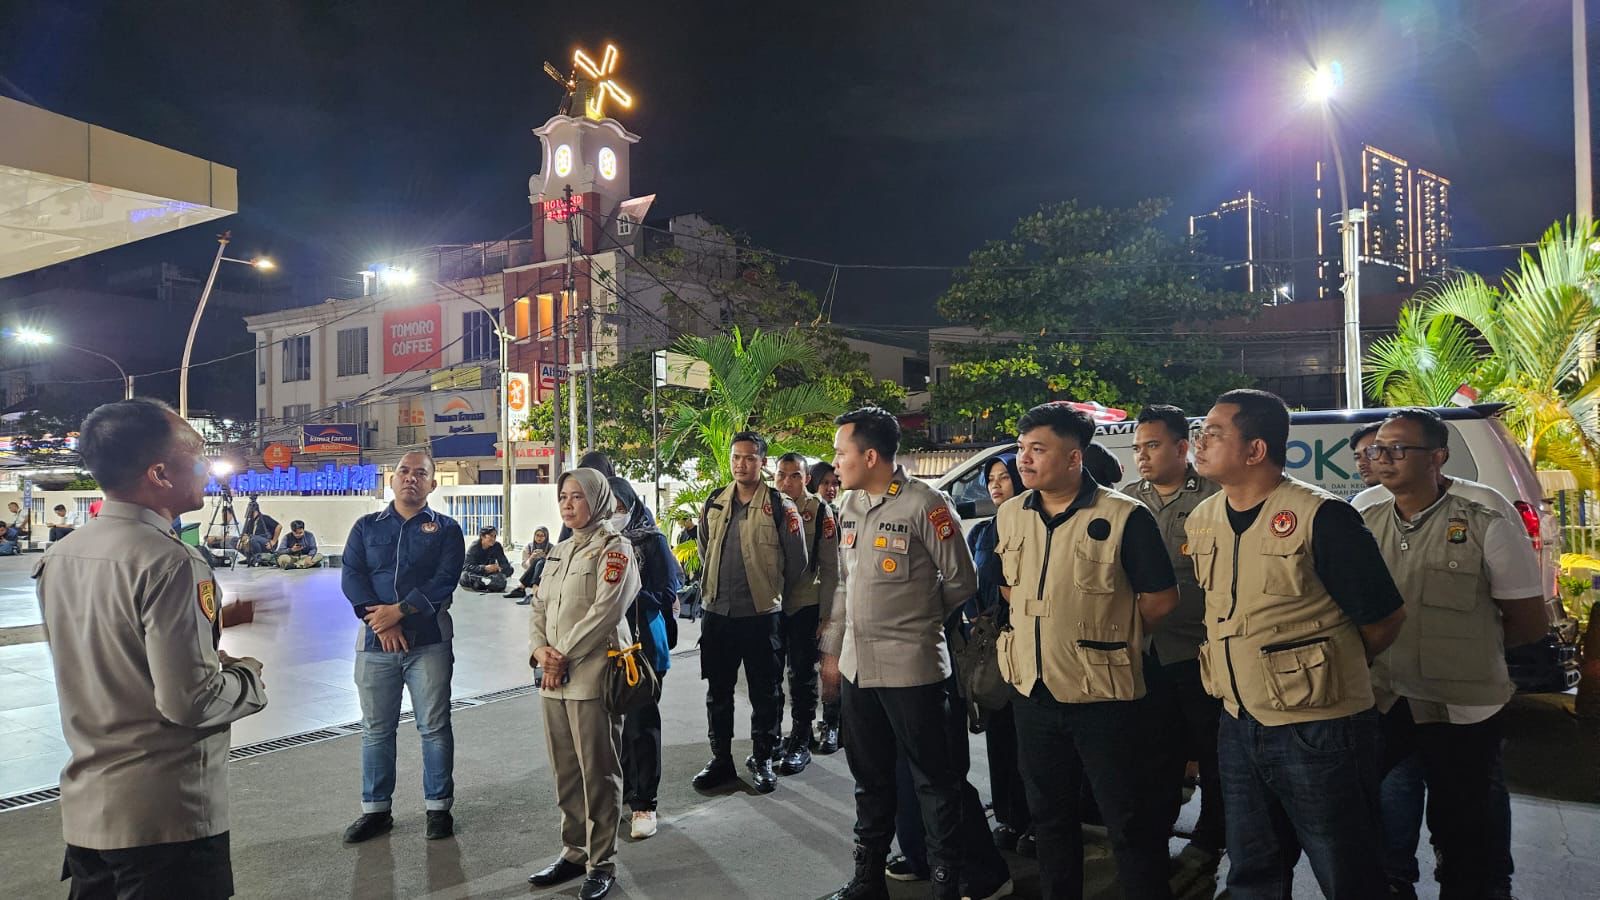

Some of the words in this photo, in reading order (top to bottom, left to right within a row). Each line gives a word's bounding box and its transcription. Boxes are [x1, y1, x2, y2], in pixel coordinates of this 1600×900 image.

[390, 320, 434, 338] TOMORO
[392, 337, 433, 356] COFFEE
[878, 521, 908, 534] POLRI
